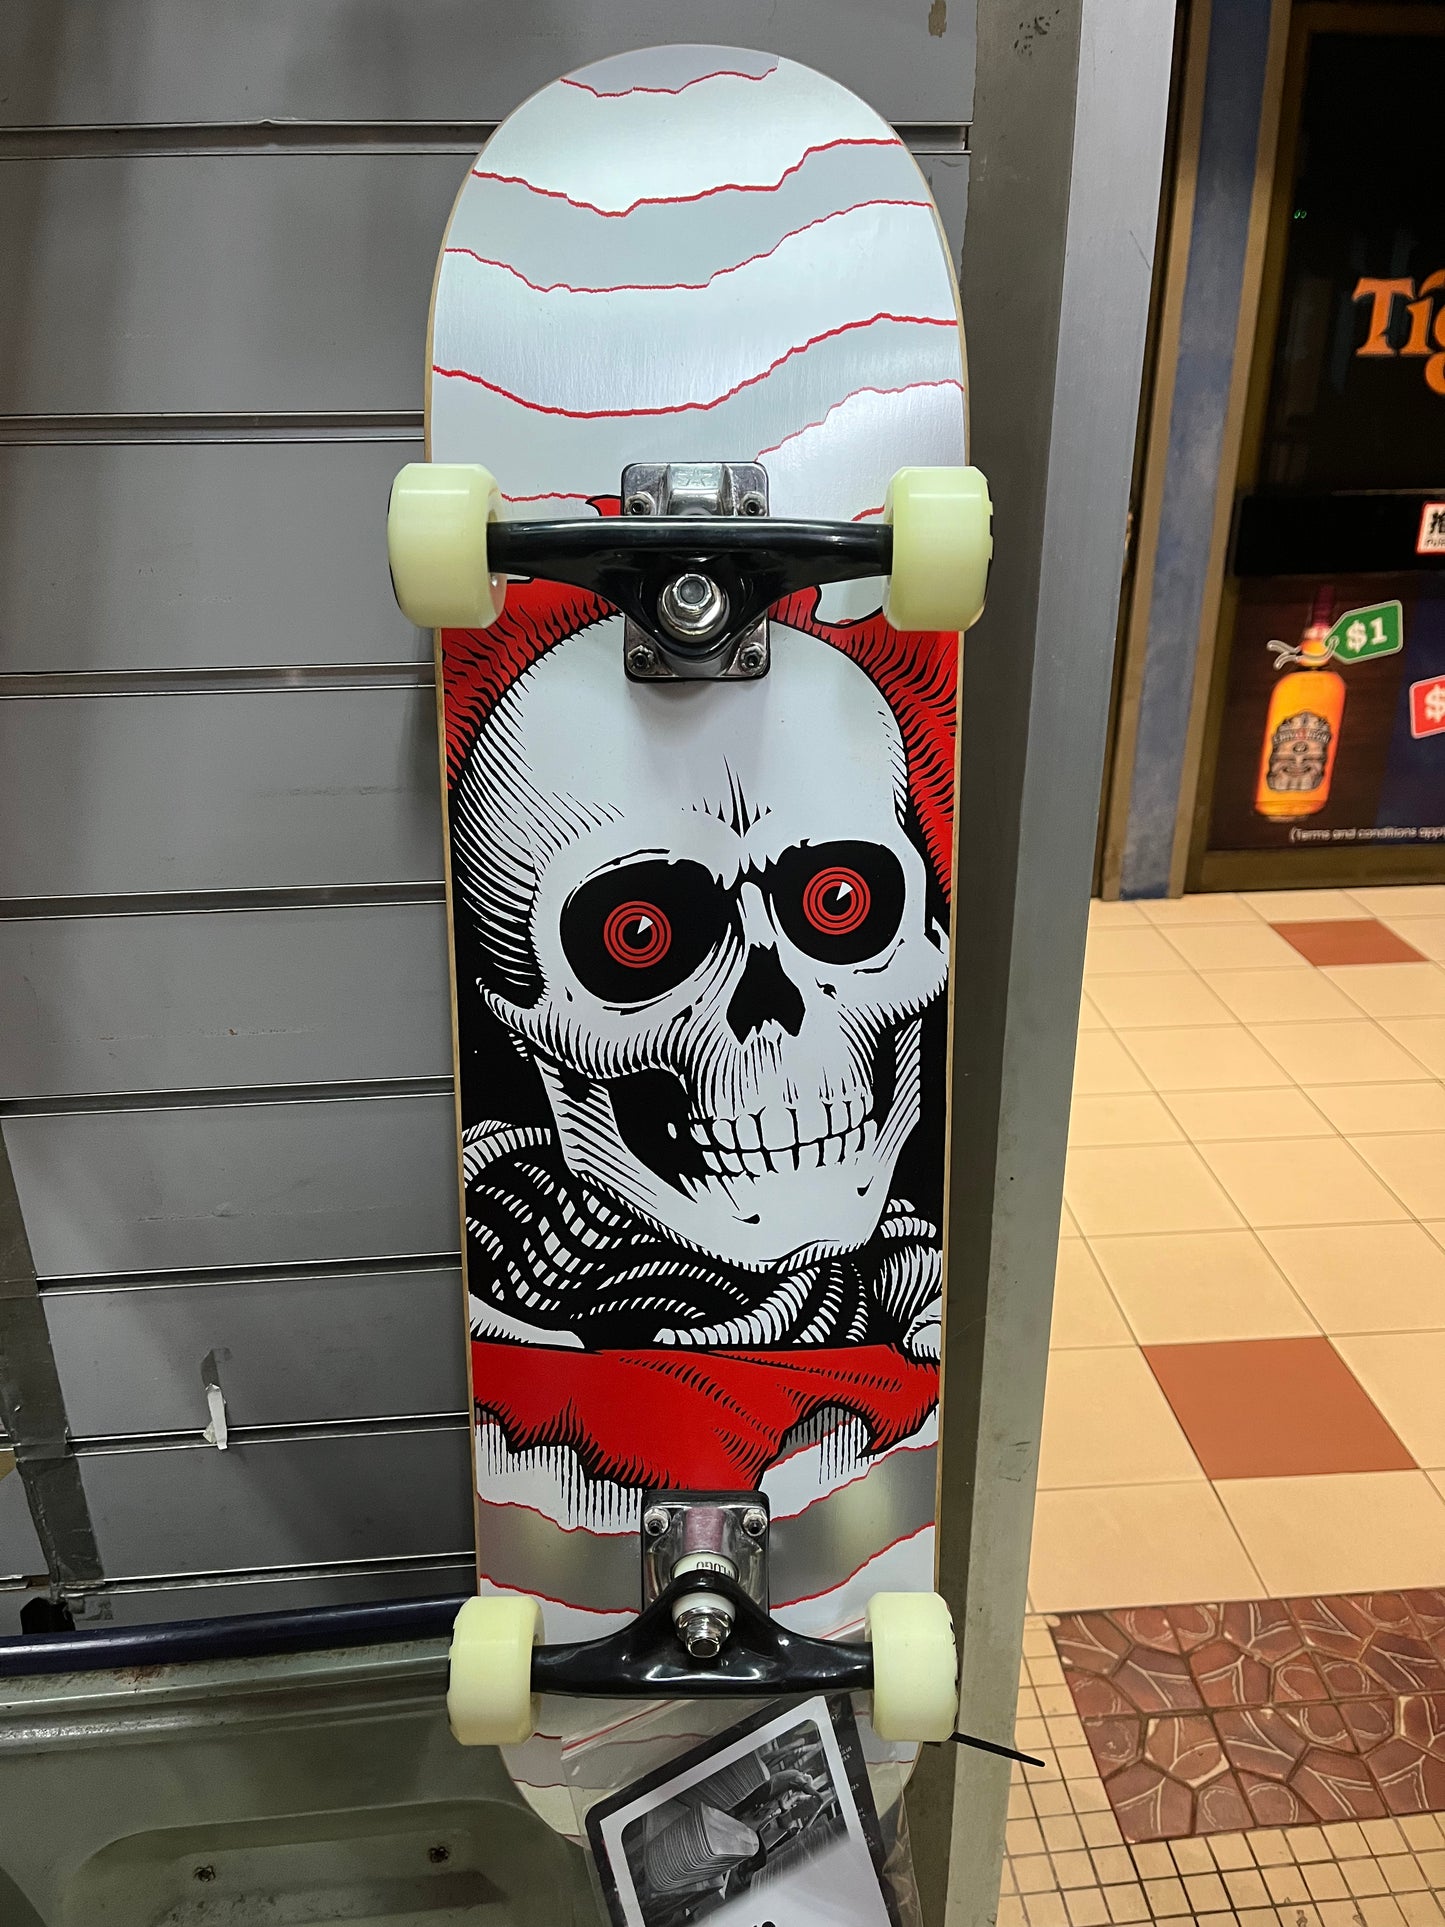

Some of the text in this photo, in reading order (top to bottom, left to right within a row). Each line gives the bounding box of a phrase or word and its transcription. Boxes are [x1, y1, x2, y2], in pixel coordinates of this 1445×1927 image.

[1352, 270, 1445, 395] Ti
[1345, 616, 1388, 654] $1
[1332, 827, 1356, 841] and
[1357, 825, 1417, 840] conditions
